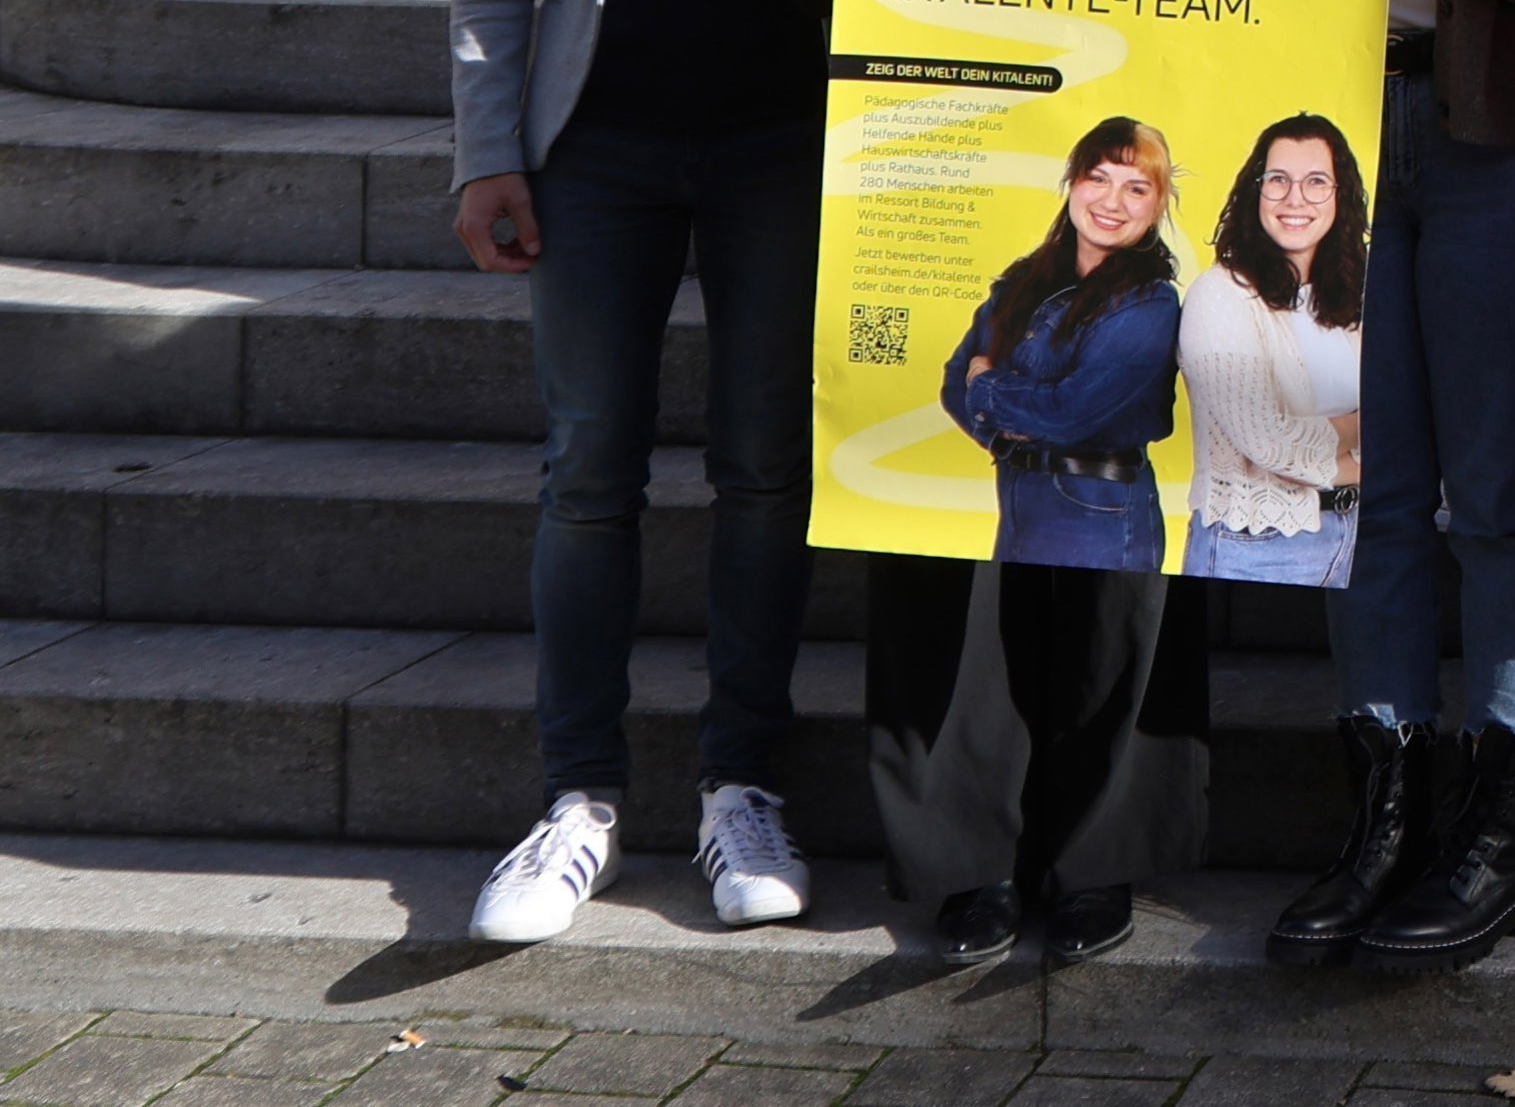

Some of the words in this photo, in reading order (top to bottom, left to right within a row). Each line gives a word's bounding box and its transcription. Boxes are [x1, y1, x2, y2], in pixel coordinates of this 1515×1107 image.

[865, 62, 895, 75] ZEIG
[896, 64, 923, 77] DER
[924, 66, 959, 79] WELT
[960, 68, 990, 81] DEIN
[992, 71, 1053, 86] KITALENT!
